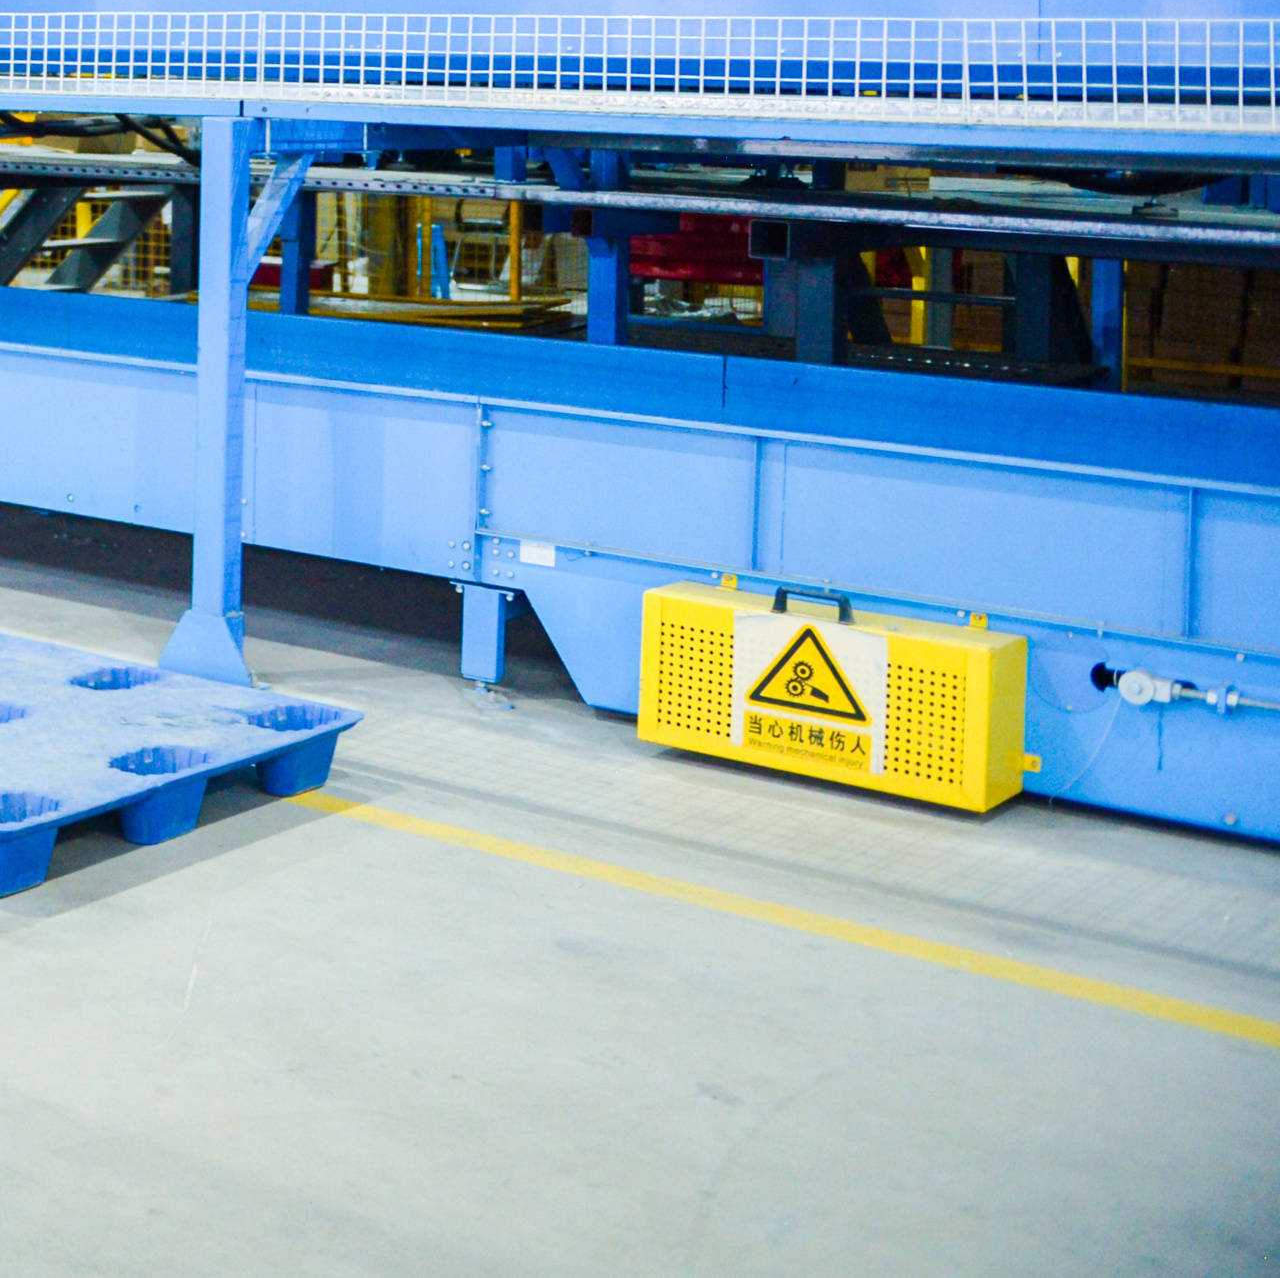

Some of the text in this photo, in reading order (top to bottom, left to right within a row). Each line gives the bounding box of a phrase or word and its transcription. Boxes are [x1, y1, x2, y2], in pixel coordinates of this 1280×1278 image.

[748, 715, 866, 756] 当心机械伤人
[748, 737, 785, 753] Warning
